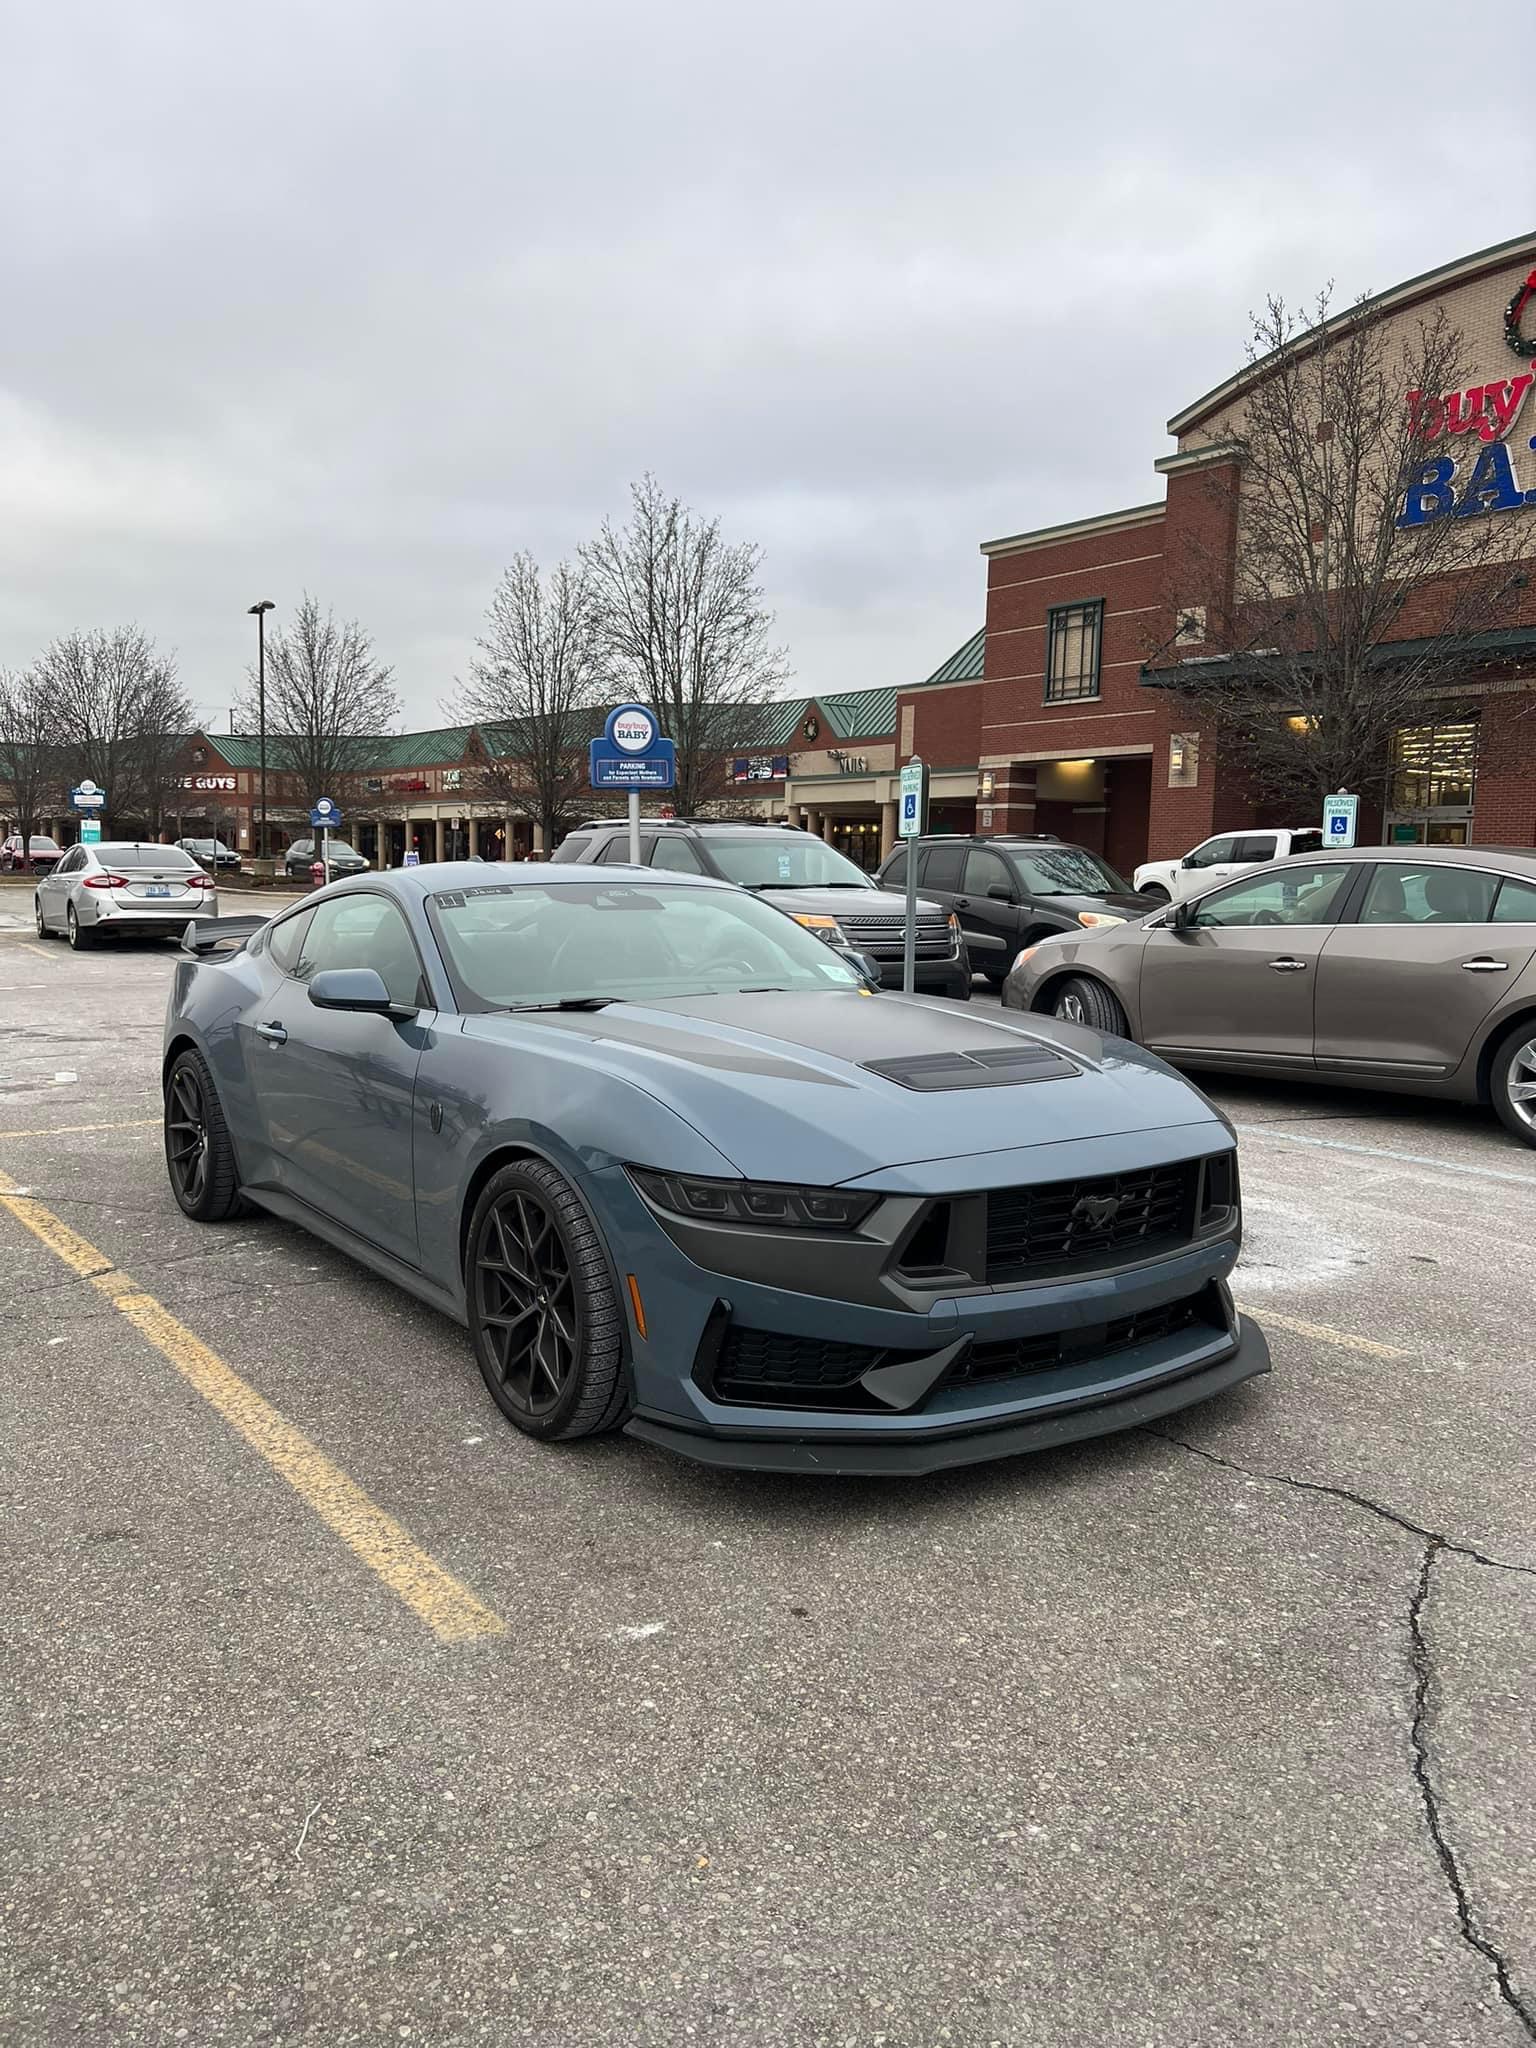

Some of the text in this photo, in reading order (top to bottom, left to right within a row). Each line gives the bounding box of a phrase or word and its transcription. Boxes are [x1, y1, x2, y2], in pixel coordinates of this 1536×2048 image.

[1405, 360, 1536, 442] buy
[1395, 441, 1536, 528] BA
[618, 730, 648, 739] BABY
[195, 777, 236, 789] GUYS
[1327, 799, 1353, 807] RESERVED
[1328, 808, 1352, 816] PARKING
